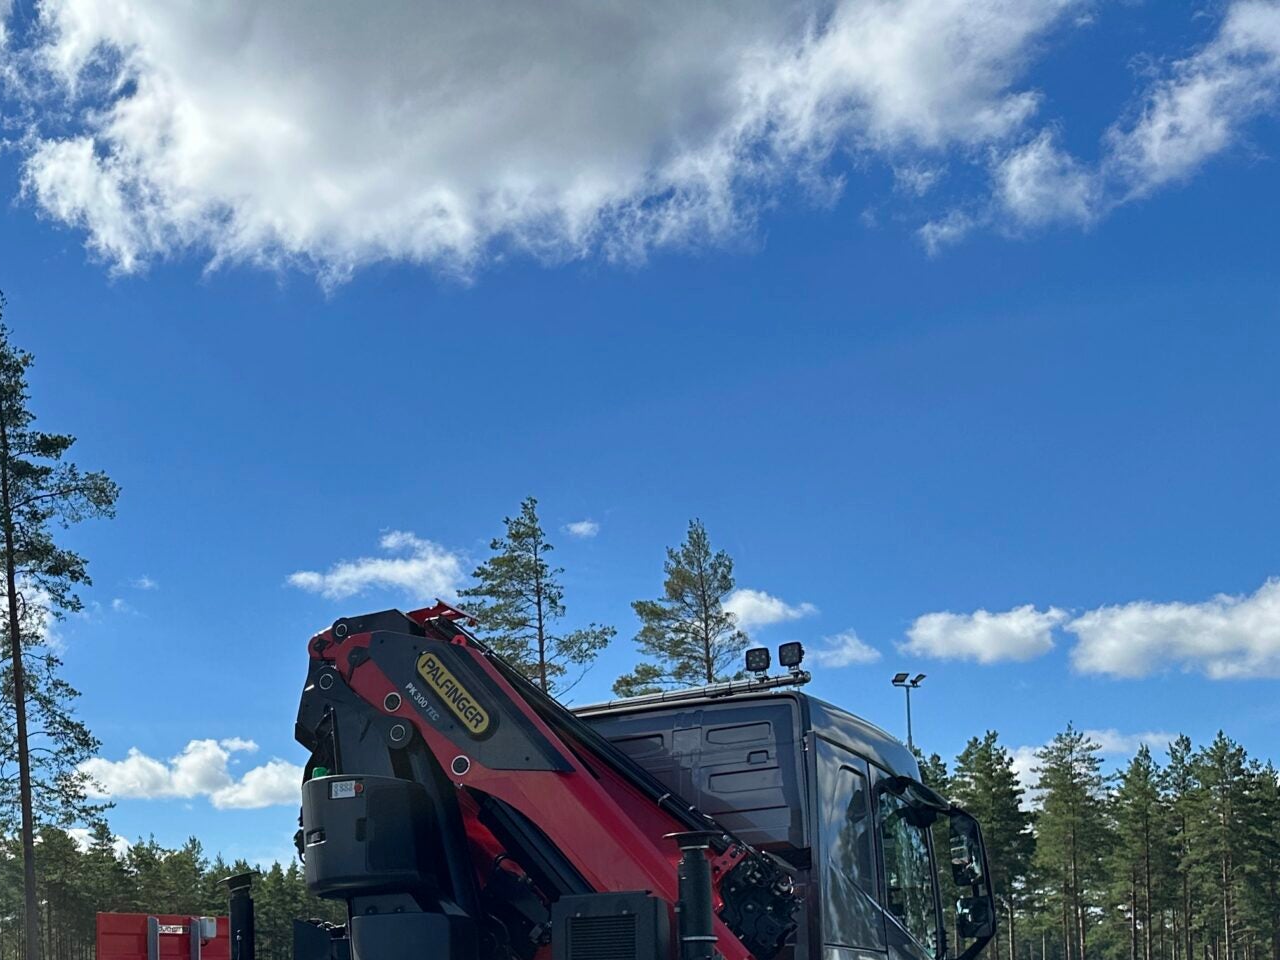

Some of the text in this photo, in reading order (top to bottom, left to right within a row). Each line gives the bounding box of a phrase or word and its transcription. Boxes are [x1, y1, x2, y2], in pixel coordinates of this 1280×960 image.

[405, 682, 440, 721] PK 300 TEC
[422, 657, 484, 729] PALFINGER
